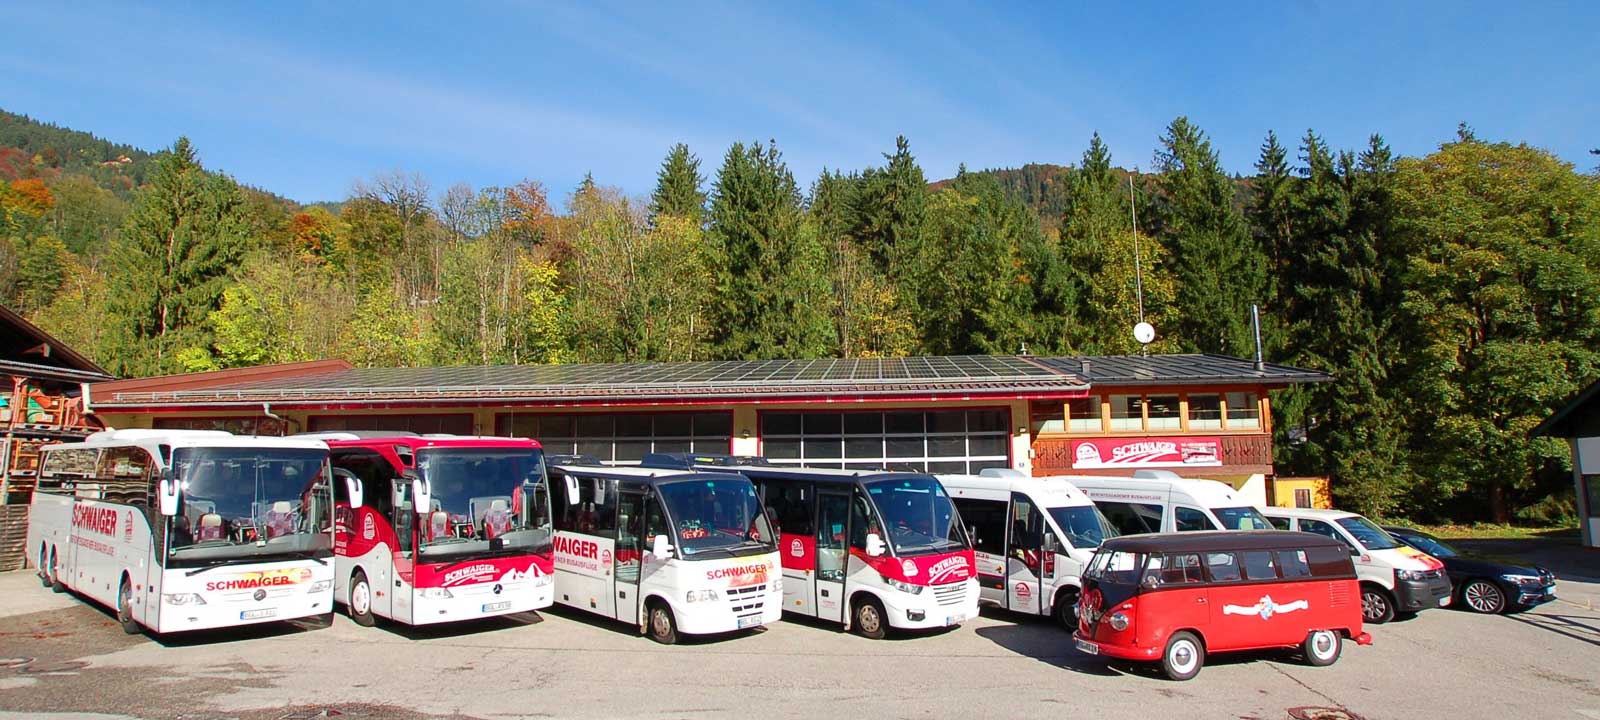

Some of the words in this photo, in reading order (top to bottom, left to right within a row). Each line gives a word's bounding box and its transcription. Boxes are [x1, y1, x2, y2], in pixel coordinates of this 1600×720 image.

[1112, 441, 1177, 459] SCHWAIGER
[72, 503, 117, 537] SCHWAIGER
[553, 536, 598, 560] WAIGER
[445, 564, 495, 581] SCHWAIGER
[706, 564, 767, 580] SCHWAIGER
[929, 556, 967, 577] SCHWAIGER
[206, 575, 289, 591] SCHWAIGER
